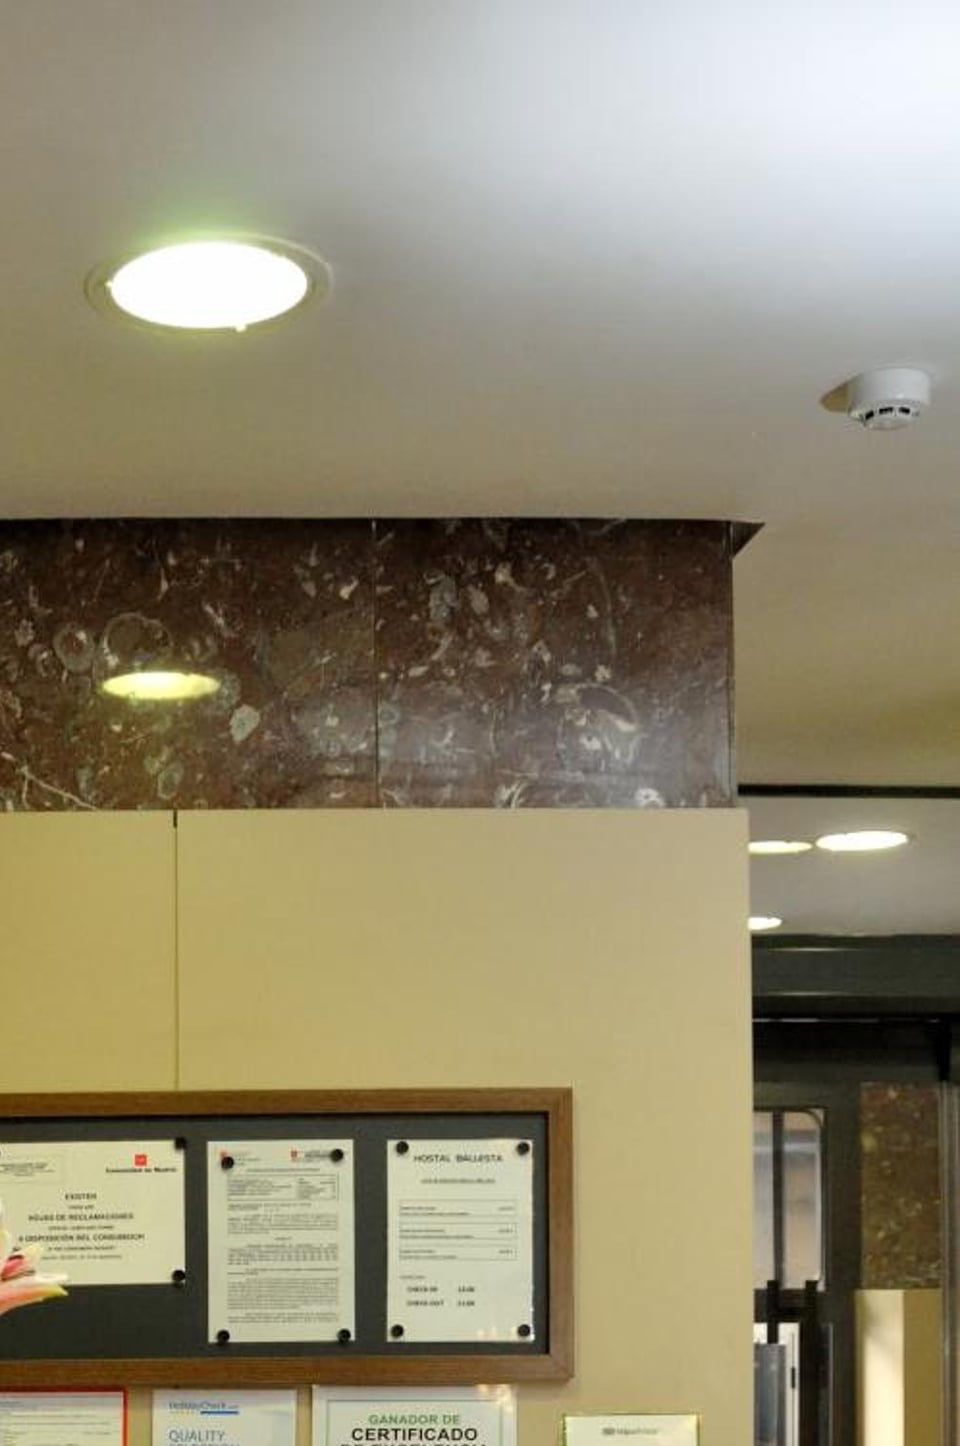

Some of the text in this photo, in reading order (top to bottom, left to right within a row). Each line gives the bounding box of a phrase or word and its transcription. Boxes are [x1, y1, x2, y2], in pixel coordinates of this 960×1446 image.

[413, 1153, 503, 1163] HOSTAL BALLESTA
[55, 1213, 67, 1221] DE
[368, 1414, 461, 1426] GANADOR DE
[168, 1430, 226, 1443] QUALITY
[350, 1427, 479, 1442] CERTIFICADO
